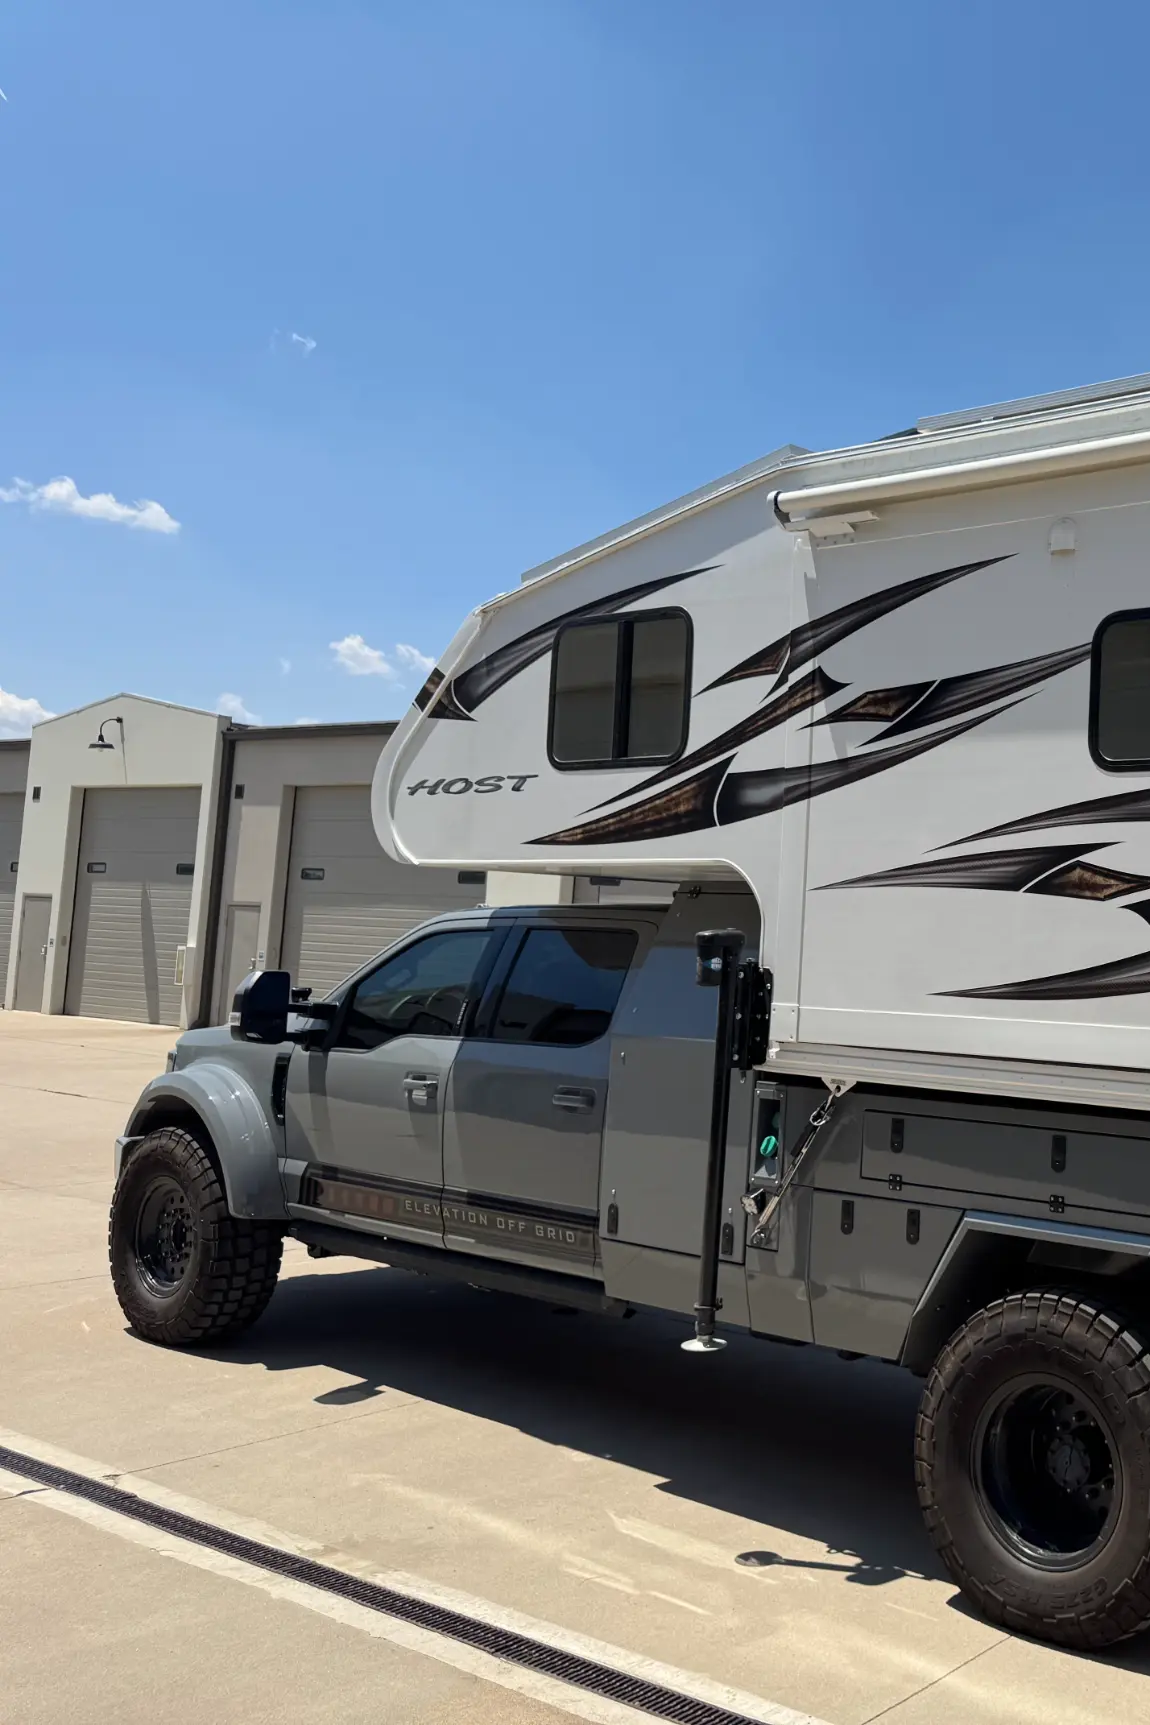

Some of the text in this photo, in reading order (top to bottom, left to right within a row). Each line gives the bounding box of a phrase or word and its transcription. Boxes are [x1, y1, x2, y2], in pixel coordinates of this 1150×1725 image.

[406, 774, 539, 796] HOST
[404, 1200, 576, 1244] ELEVATION OFF GRID
